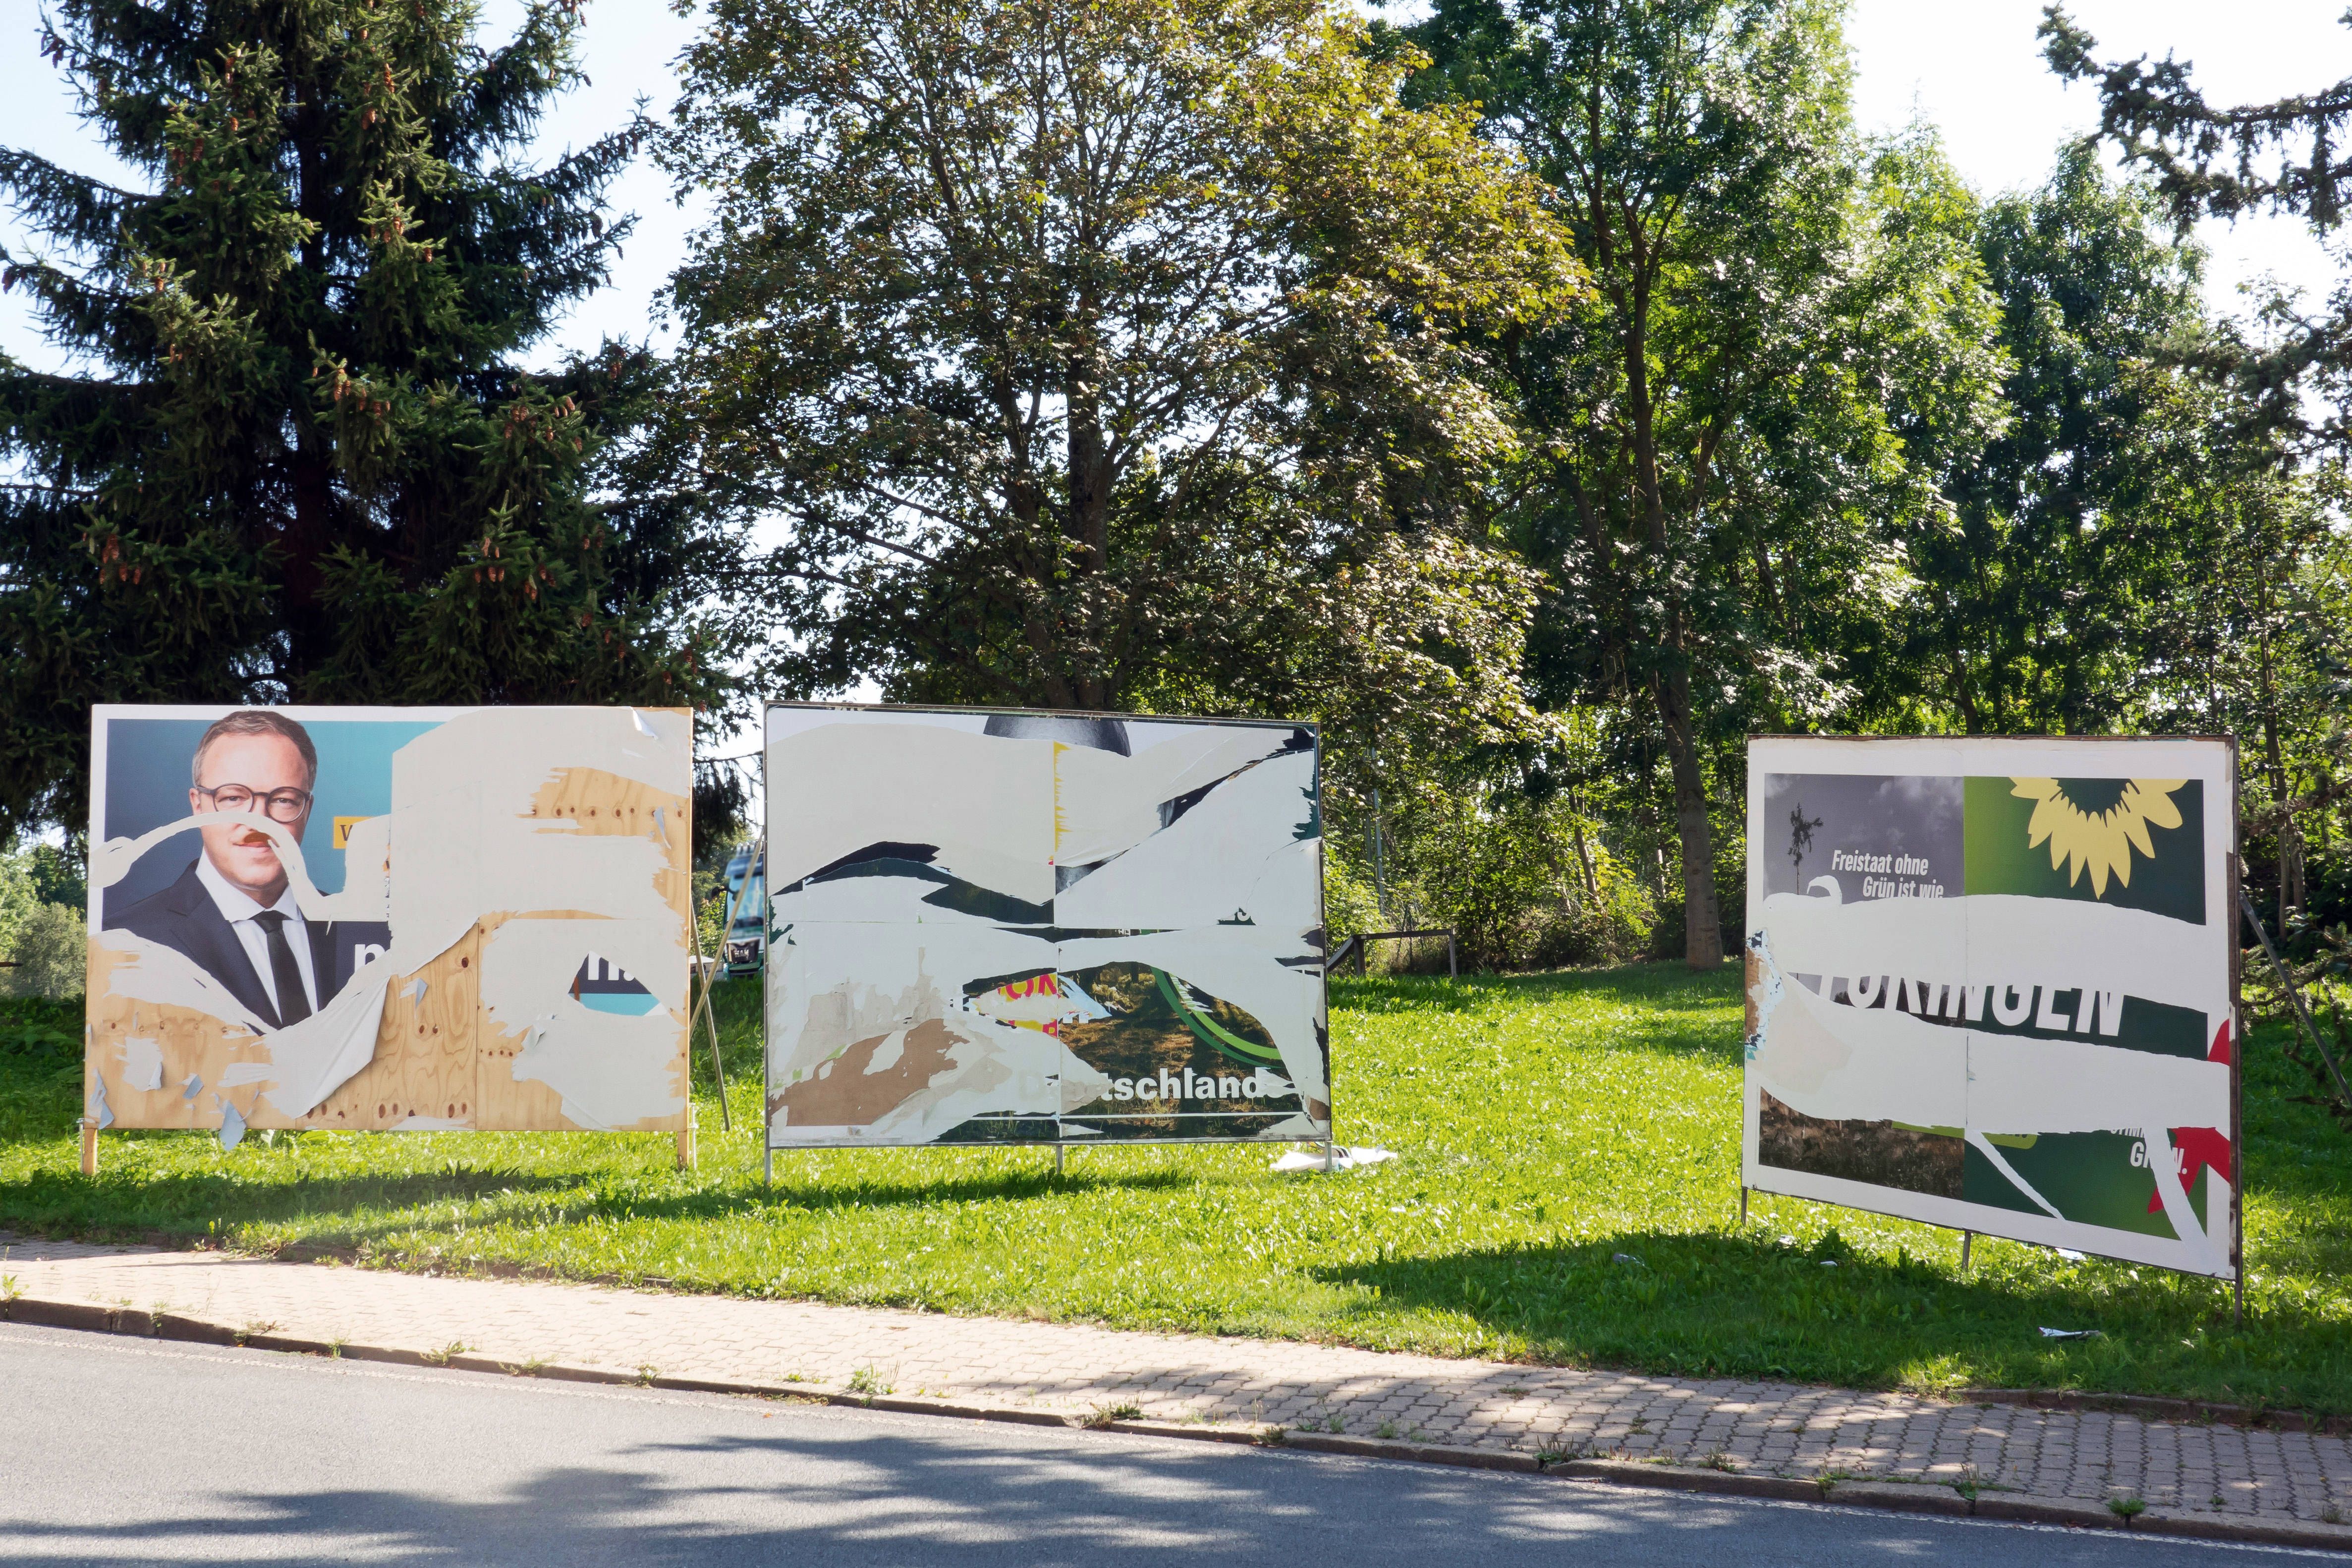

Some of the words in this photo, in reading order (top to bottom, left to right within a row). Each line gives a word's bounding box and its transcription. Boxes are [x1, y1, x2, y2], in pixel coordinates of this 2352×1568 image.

[1832, 849, 1892, 873] Freistaat
[1895, 853, 1929, 876] ohne
[1863, 876, 1895, 897] Grün
[1898, 877, 1916, 897] ist
[1919, 879, 1944, 898] wie
